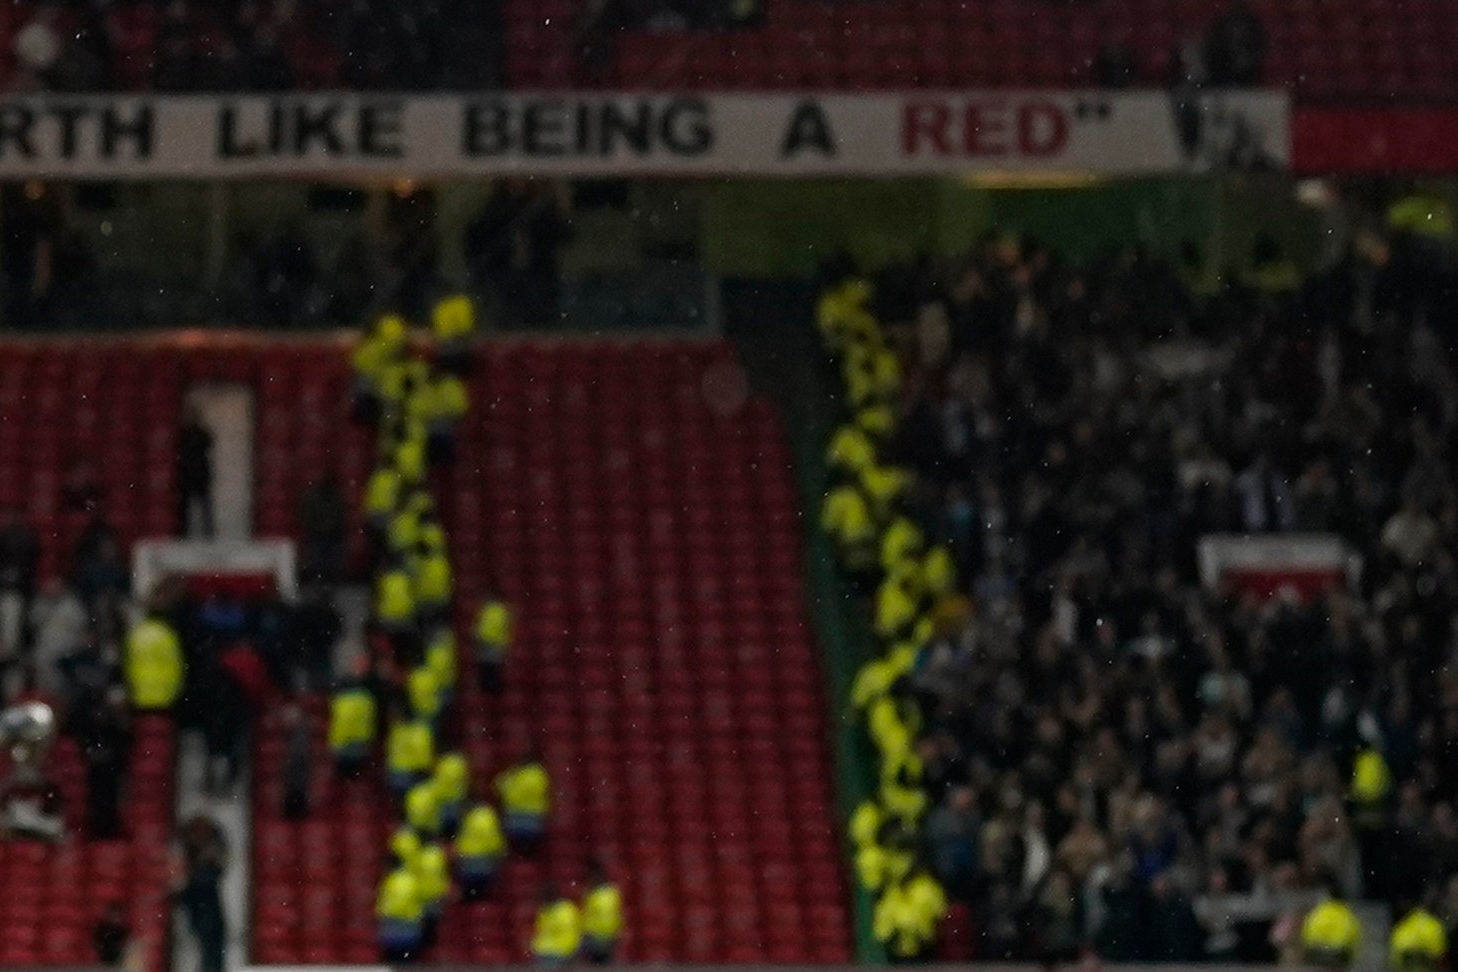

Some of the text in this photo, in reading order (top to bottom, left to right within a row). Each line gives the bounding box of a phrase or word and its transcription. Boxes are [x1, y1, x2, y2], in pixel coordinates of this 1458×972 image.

[215, 100, 403, 159] LIKE
[462, 98, 716, 158] BEING
[780, 97, 838, 157] A
[900, 97, 1113, 158] RED"
